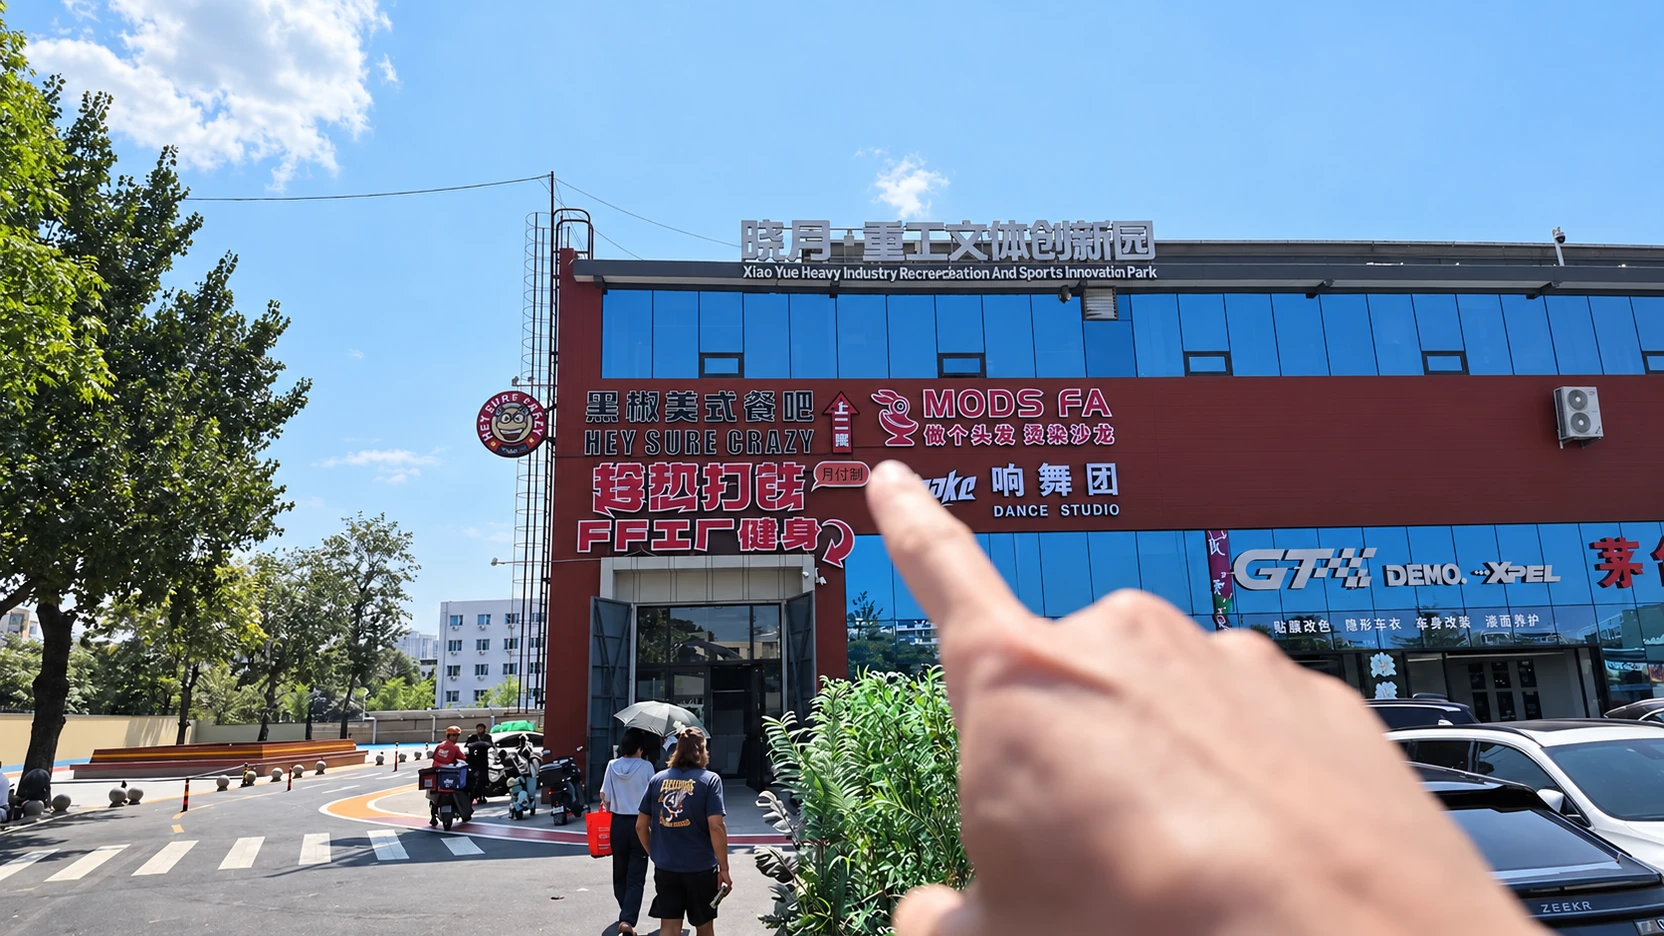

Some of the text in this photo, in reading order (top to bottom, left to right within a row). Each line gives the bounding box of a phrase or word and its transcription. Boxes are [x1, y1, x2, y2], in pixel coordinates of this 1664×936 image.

[743, 266, 772, 279] Xiao
[775, 266, 799, 279] Yue
[801, 266, 841, 281] Heavy
[843, 266, 897, 282] Industry
[991, 266, 1017, 279] And
[1019, 266, 1063, 281] Sports
[1127, 265, 1157, 279] Park
[585, 390, 814, 423] 黑椒美式餐吧
[922, 388, 1112, 418] MODS FA
[480, 415, 494, 442] HEY
[923, 423, 1115, 446] 做个头发 烫染沙龙
[584, 429, 814, 456] HEY SURE CRAZY
[821, 466, 863, 482] 月付制
[921, 469, 977, 503] ake
[991, 462, 1119, 497] 响舞团
[993, 503, 1120, 517] DANCE STUDIO
[577, 517, 822, 553] FF工厂健身
[1345, 617, 1402, 632] 隐形车衣
[1415, 615, 1471, 631] 车身改装
[1541, 901, 1592, 913] ZEEKR
